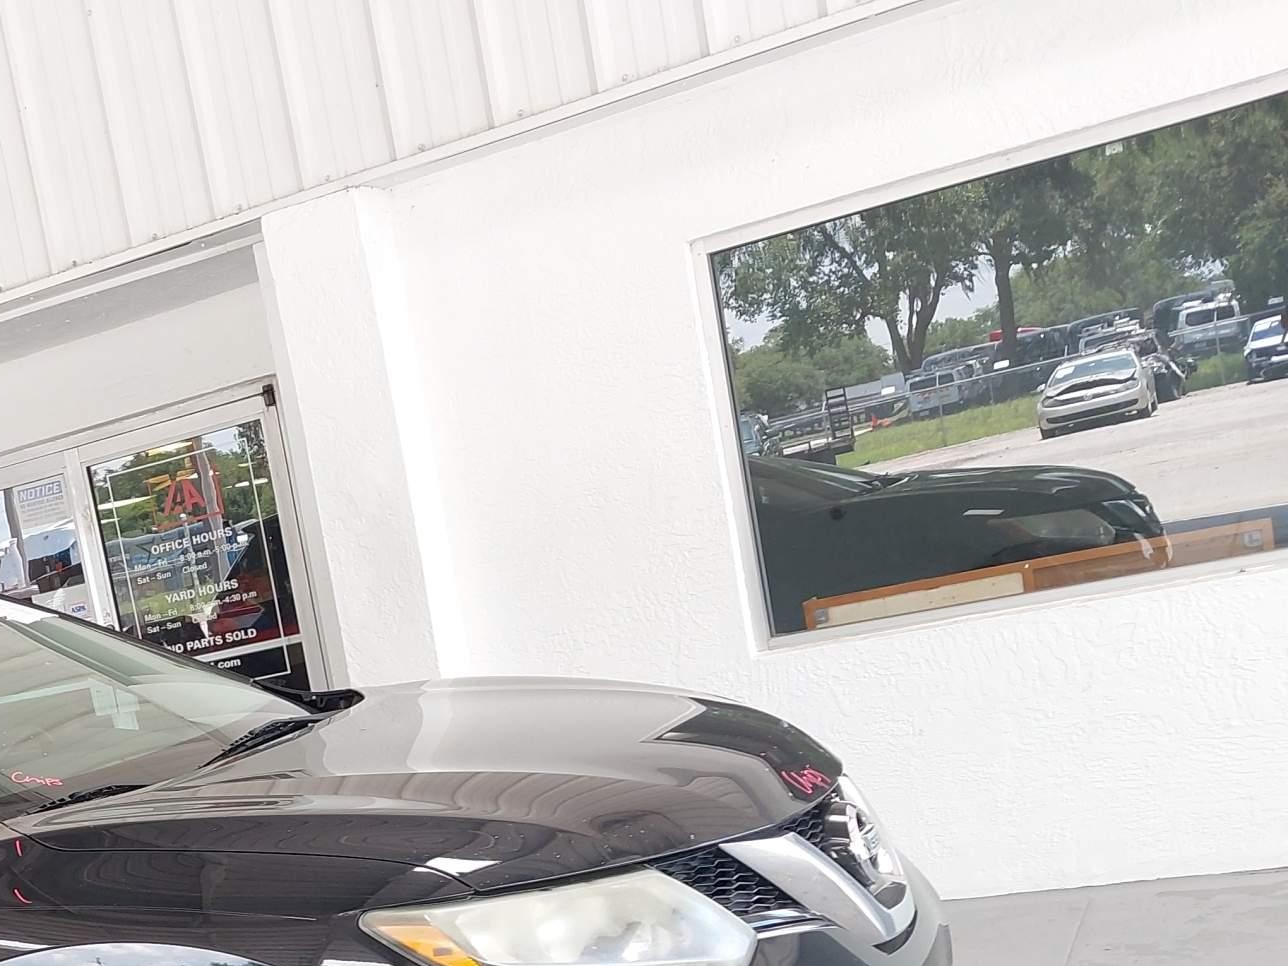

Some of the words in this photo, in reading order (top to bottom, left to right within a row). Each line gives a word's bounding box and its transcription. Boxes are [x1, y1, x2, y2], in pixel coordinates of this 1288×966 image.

[19, 481, 61, 502] NOTICE
[151, 538, 192, 555] OFFICE
[192, 527, 233, 545] HOURS
[137, 576, 150, 585] Sat
[156, 571, 172, 580] Sun
[182, 562, 208, 574] Closed
[164, 589, 196, 604] YARD
[198, 579, 239, 597] HOURS
[147, 626, 160, 634] Sat
[166, 621, 182, 630] Sun
[186, 635, 224, 651] PARTS
[225, 628, 257, 642] SOLD
